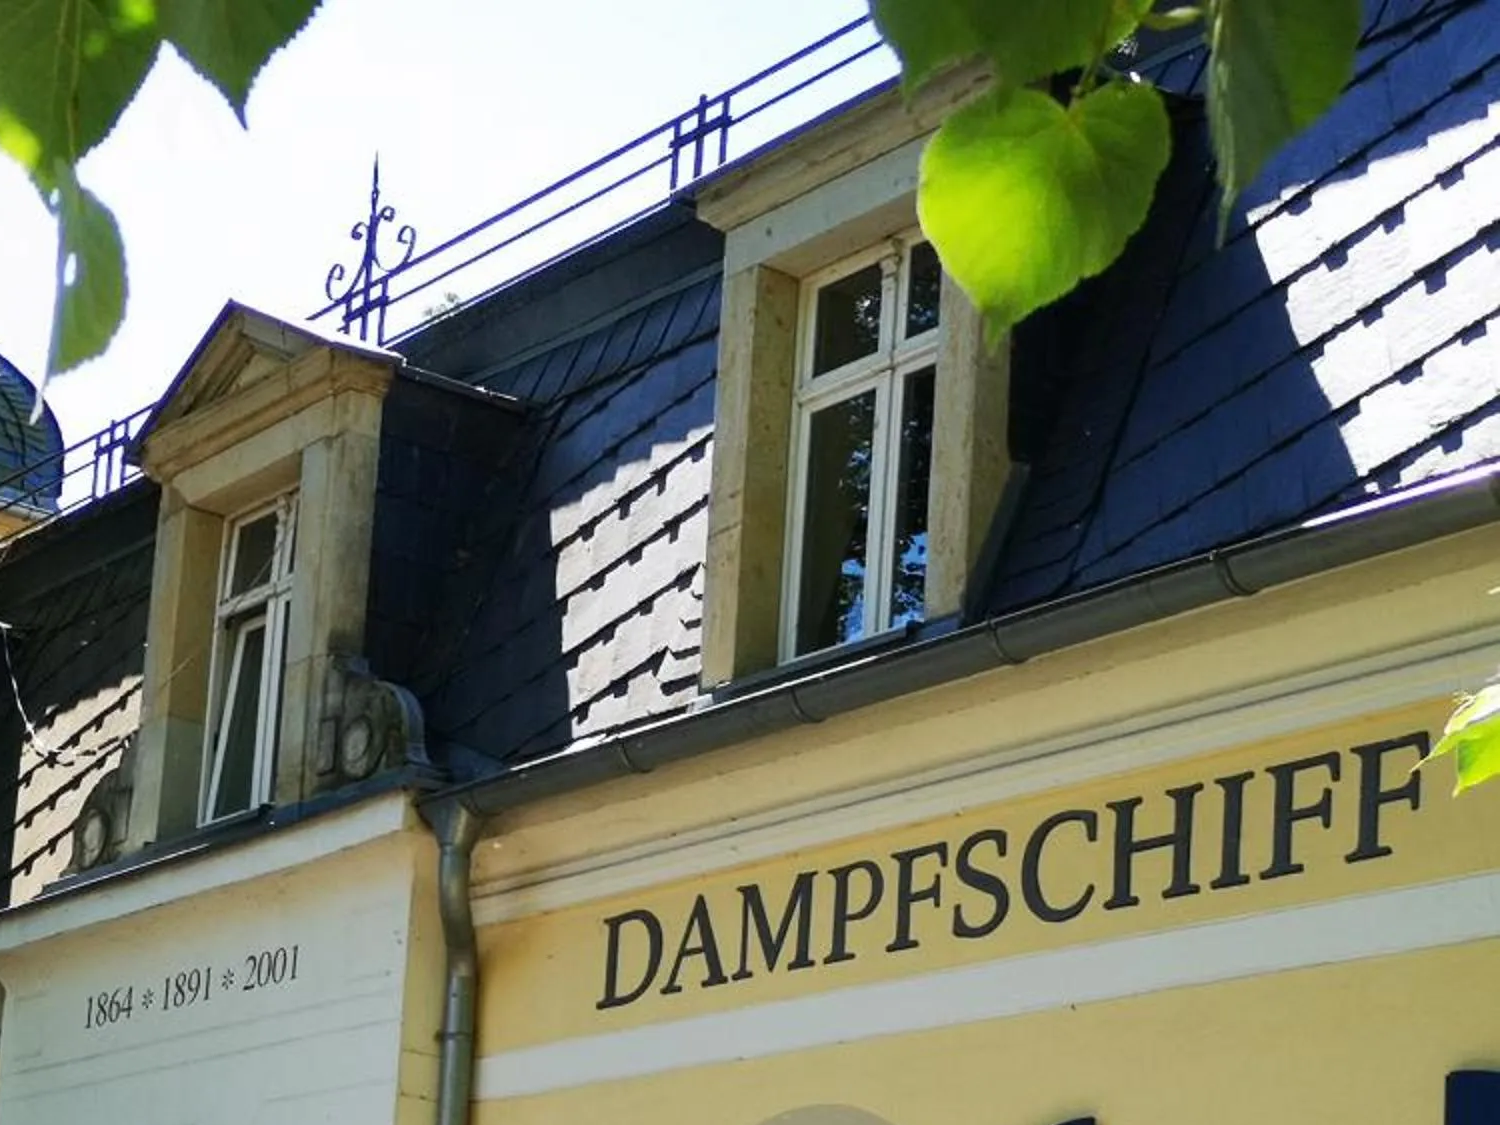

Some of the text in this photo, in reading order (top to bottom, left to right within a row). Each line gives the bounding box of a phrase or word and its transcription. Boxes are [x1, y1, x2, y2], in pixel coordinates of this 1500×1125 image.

[596, 731, 1431, 1010] DAMPFSCHIFF
[84, 945, 299, 1029] 1864 1891 2001
